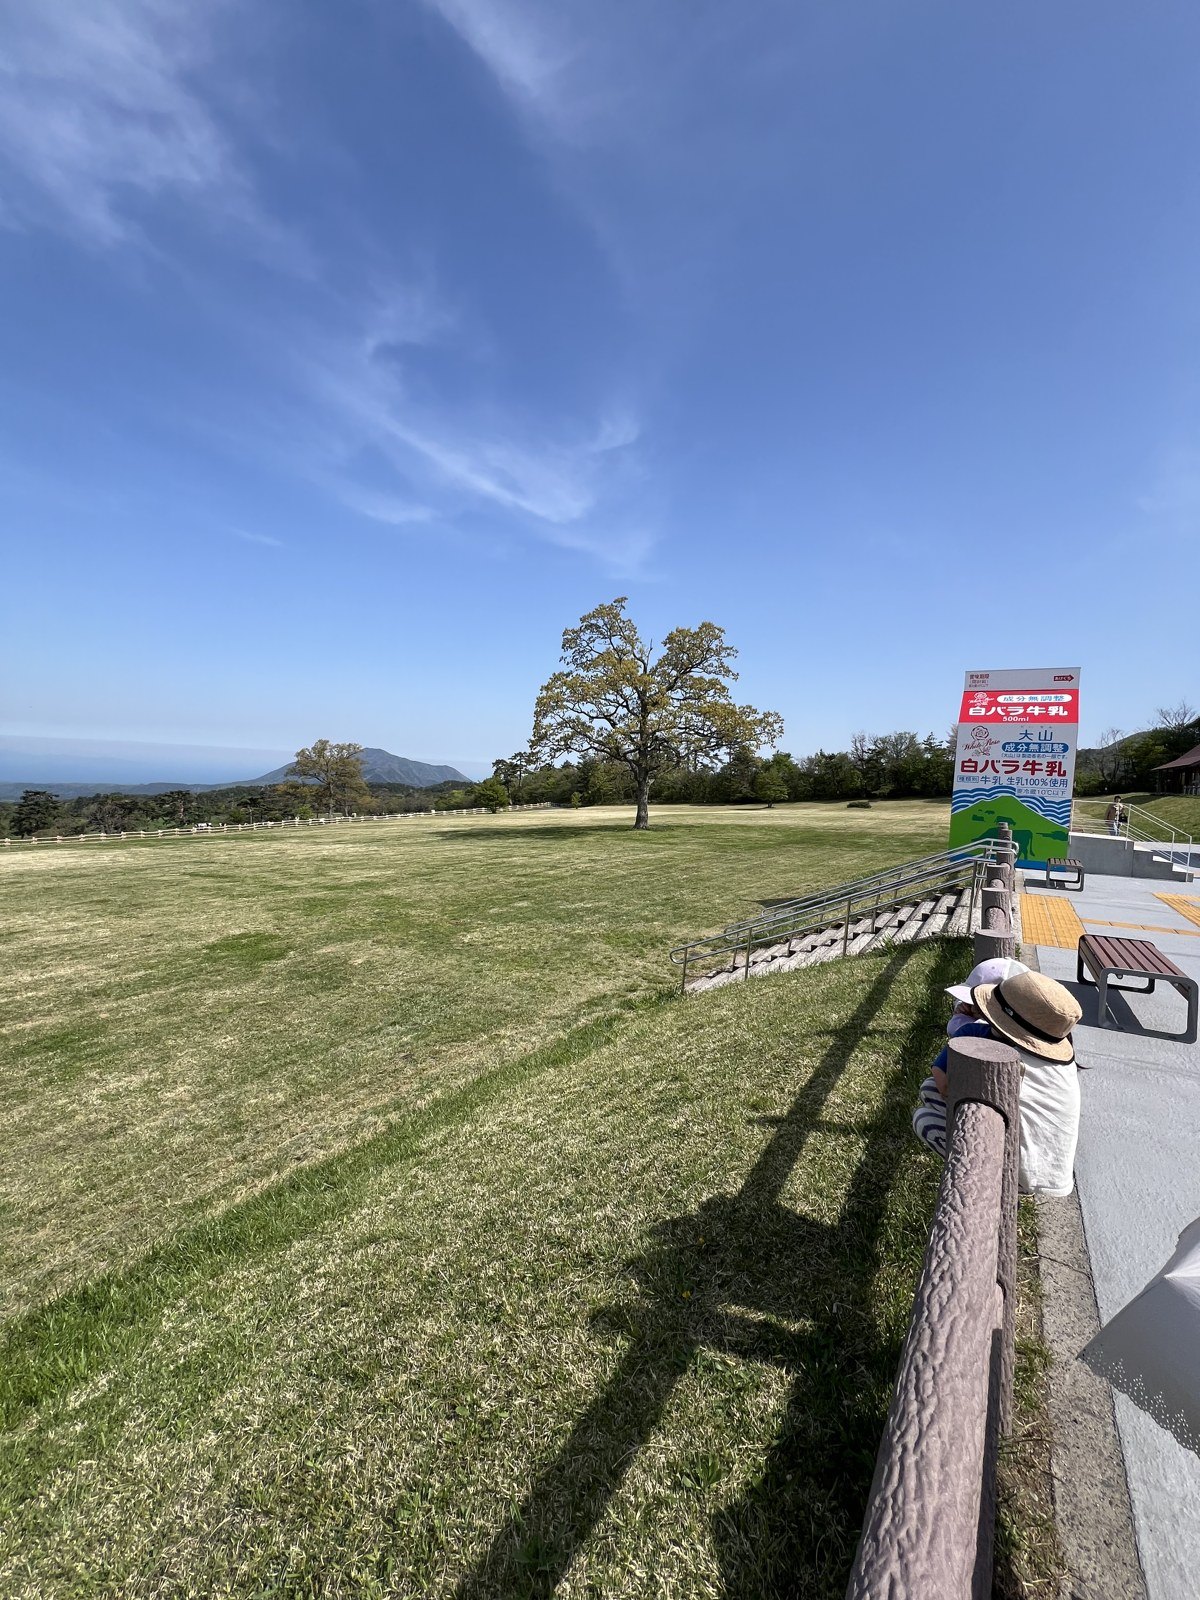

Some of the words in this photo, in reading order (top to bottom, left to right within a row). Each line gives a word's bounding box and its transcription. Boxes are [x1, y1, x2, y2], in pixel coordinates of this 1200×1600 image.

[968, 706, 1068, 716] 白バラ牛乳
[1019, 729, 1053, 742] 大山
[1004, 743, 1065, 753] 成分無調整
[960, 758, 1067, 777] 白バラ牛乳
[980, 775, 1003, 786] 牛乳
